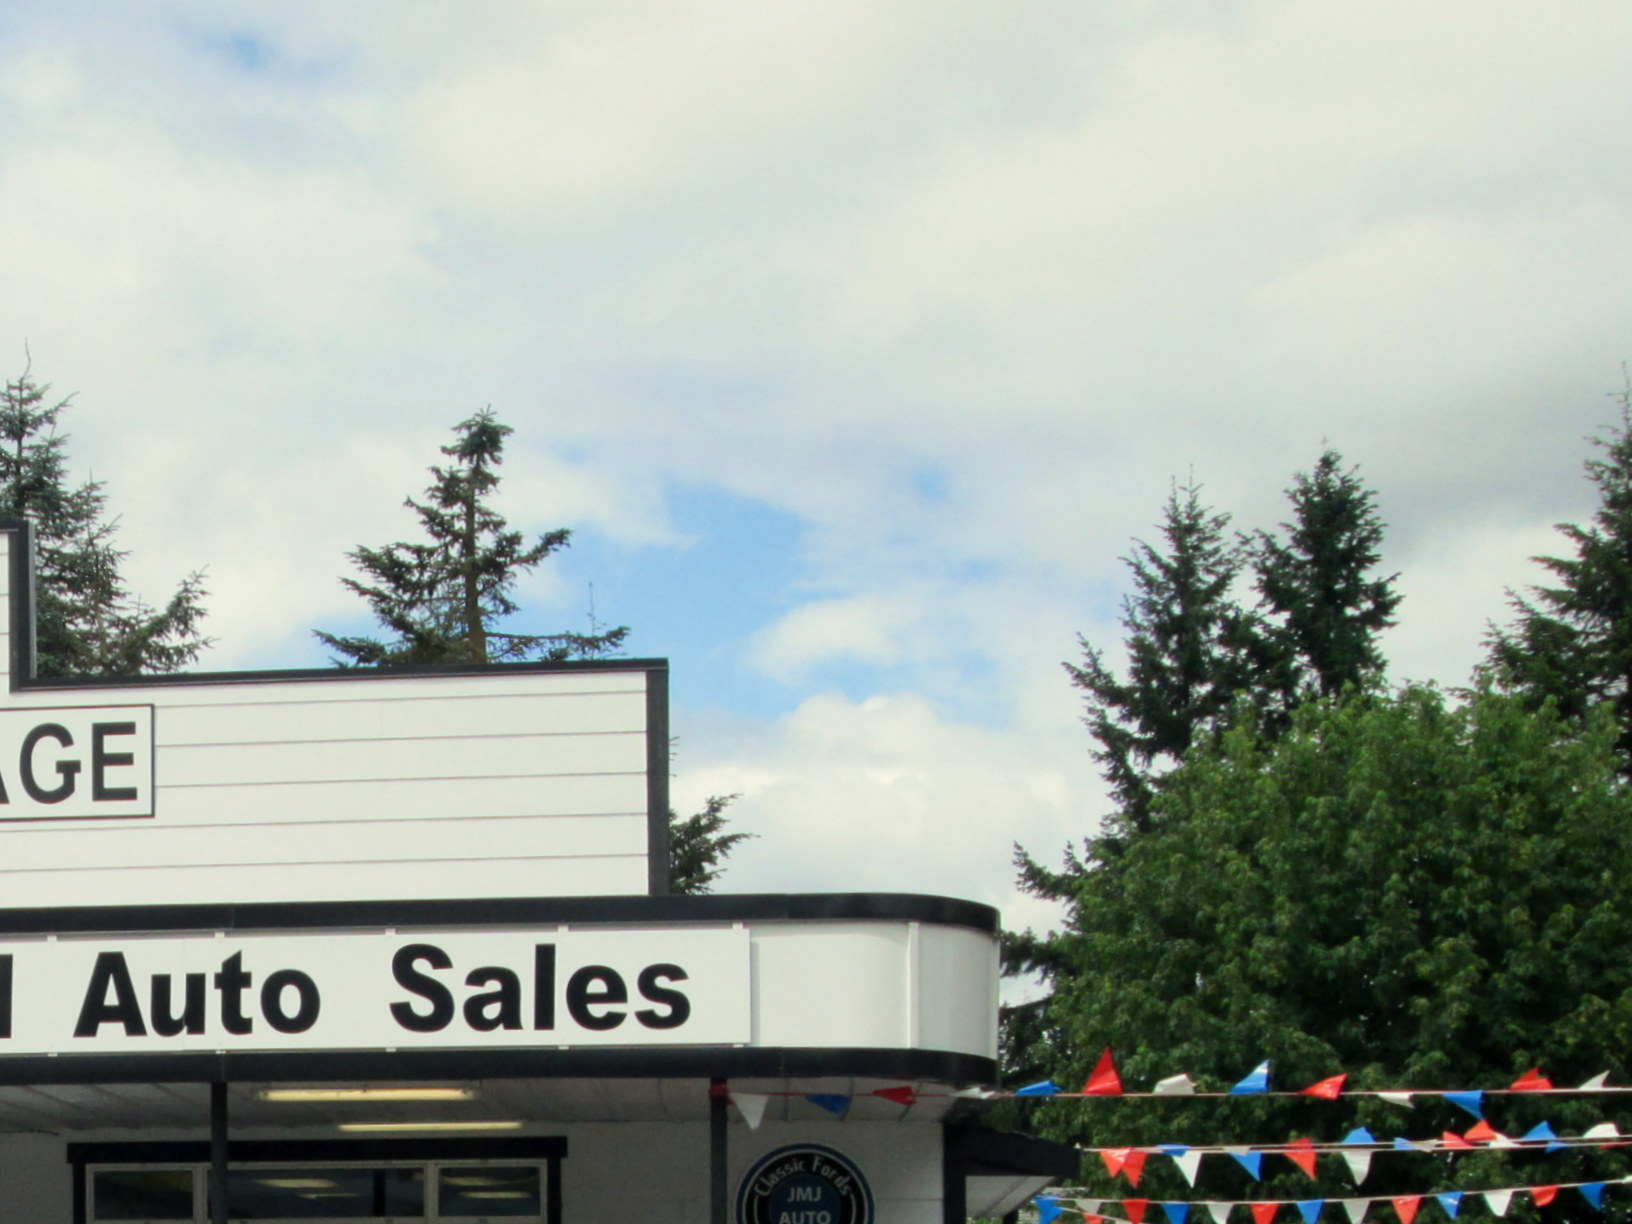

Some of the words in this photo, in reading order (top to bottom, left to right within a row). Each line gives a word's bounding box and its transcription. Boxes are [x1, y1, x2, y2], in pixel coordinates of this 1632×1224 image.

[72, 948, 322, 1038] Auto
[389, 942, 691, 1033] Sales
[753, 1158, 807, 1197] Classic
[811, 1155, 852, 1197] Fords
[787, 1186, 822, 1203] JMJ
